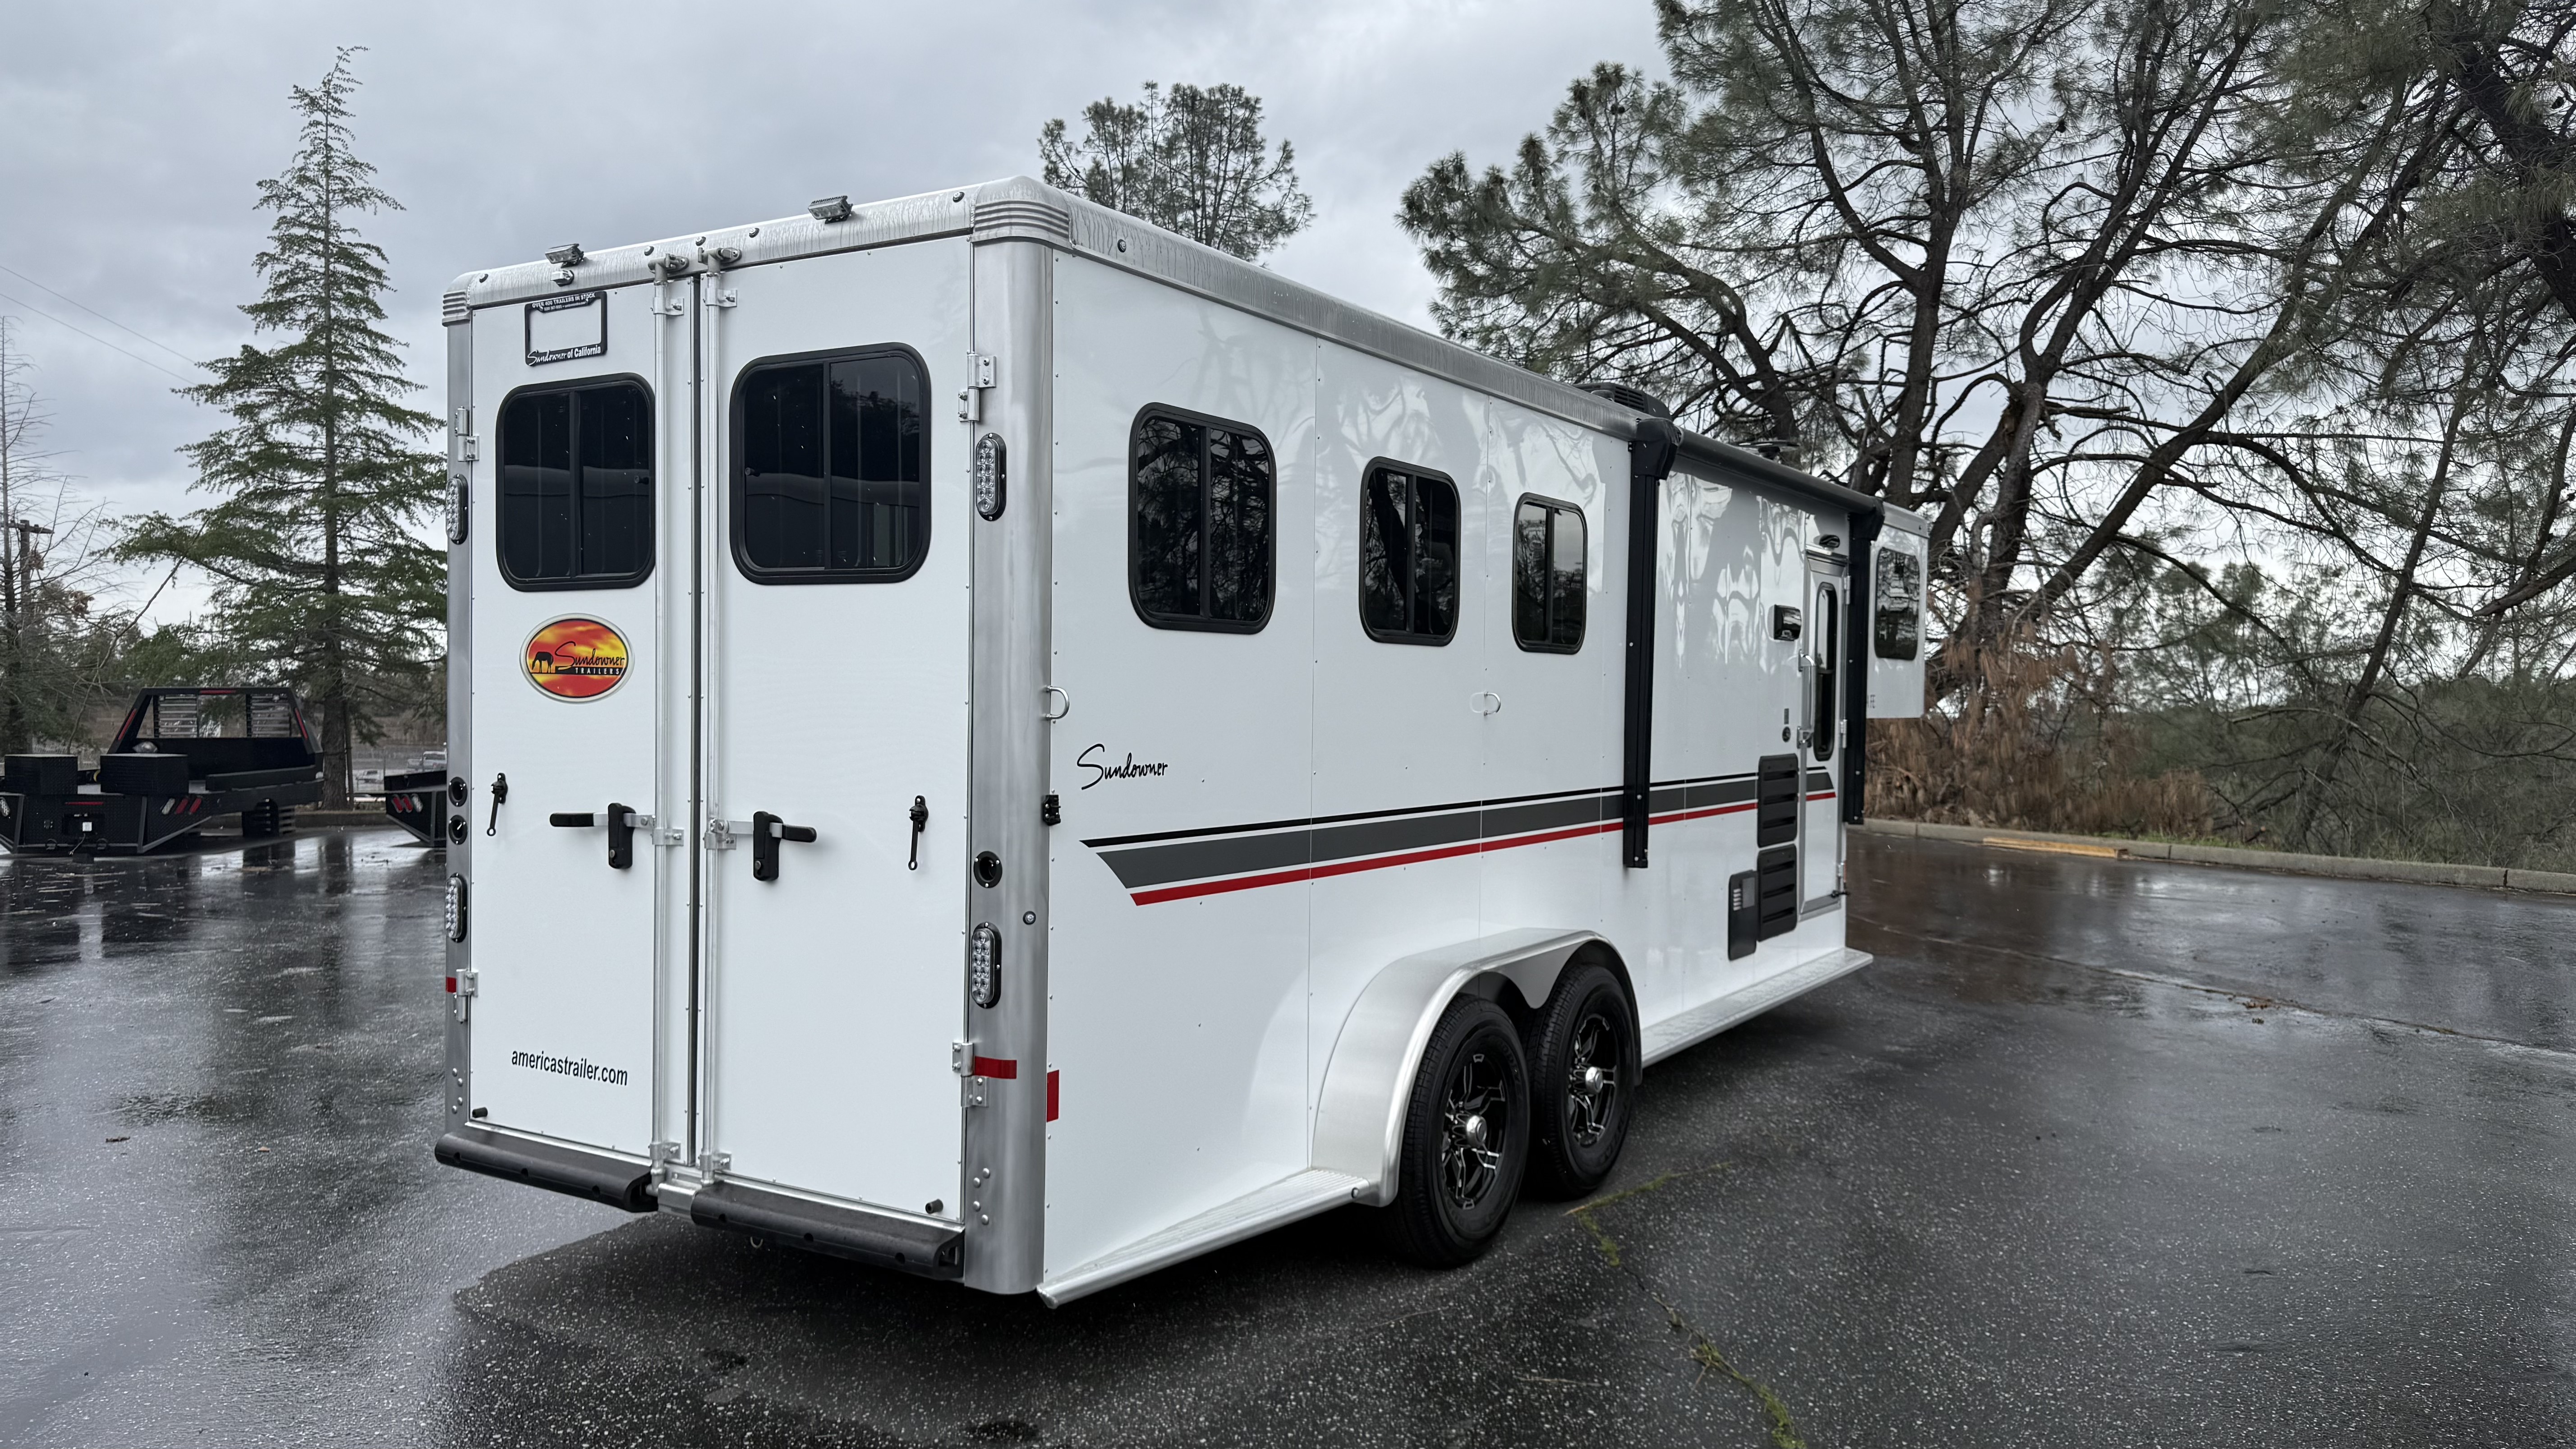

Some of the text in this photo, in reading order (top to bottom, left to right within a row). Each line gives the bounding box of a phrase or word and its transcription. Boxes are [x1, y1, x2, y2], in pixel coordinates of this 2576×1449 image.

[553, 296, 574, 304] TRAILERS
[580, 292, 595, 300] STOCK
[527, 345, 601, 366] Sundowner of California
[555, 641, 625, 670] Sundowner
[1076, 743, 1168, 790] Sundowner
[511, 1050, 628, 1086] americastrailer.com
